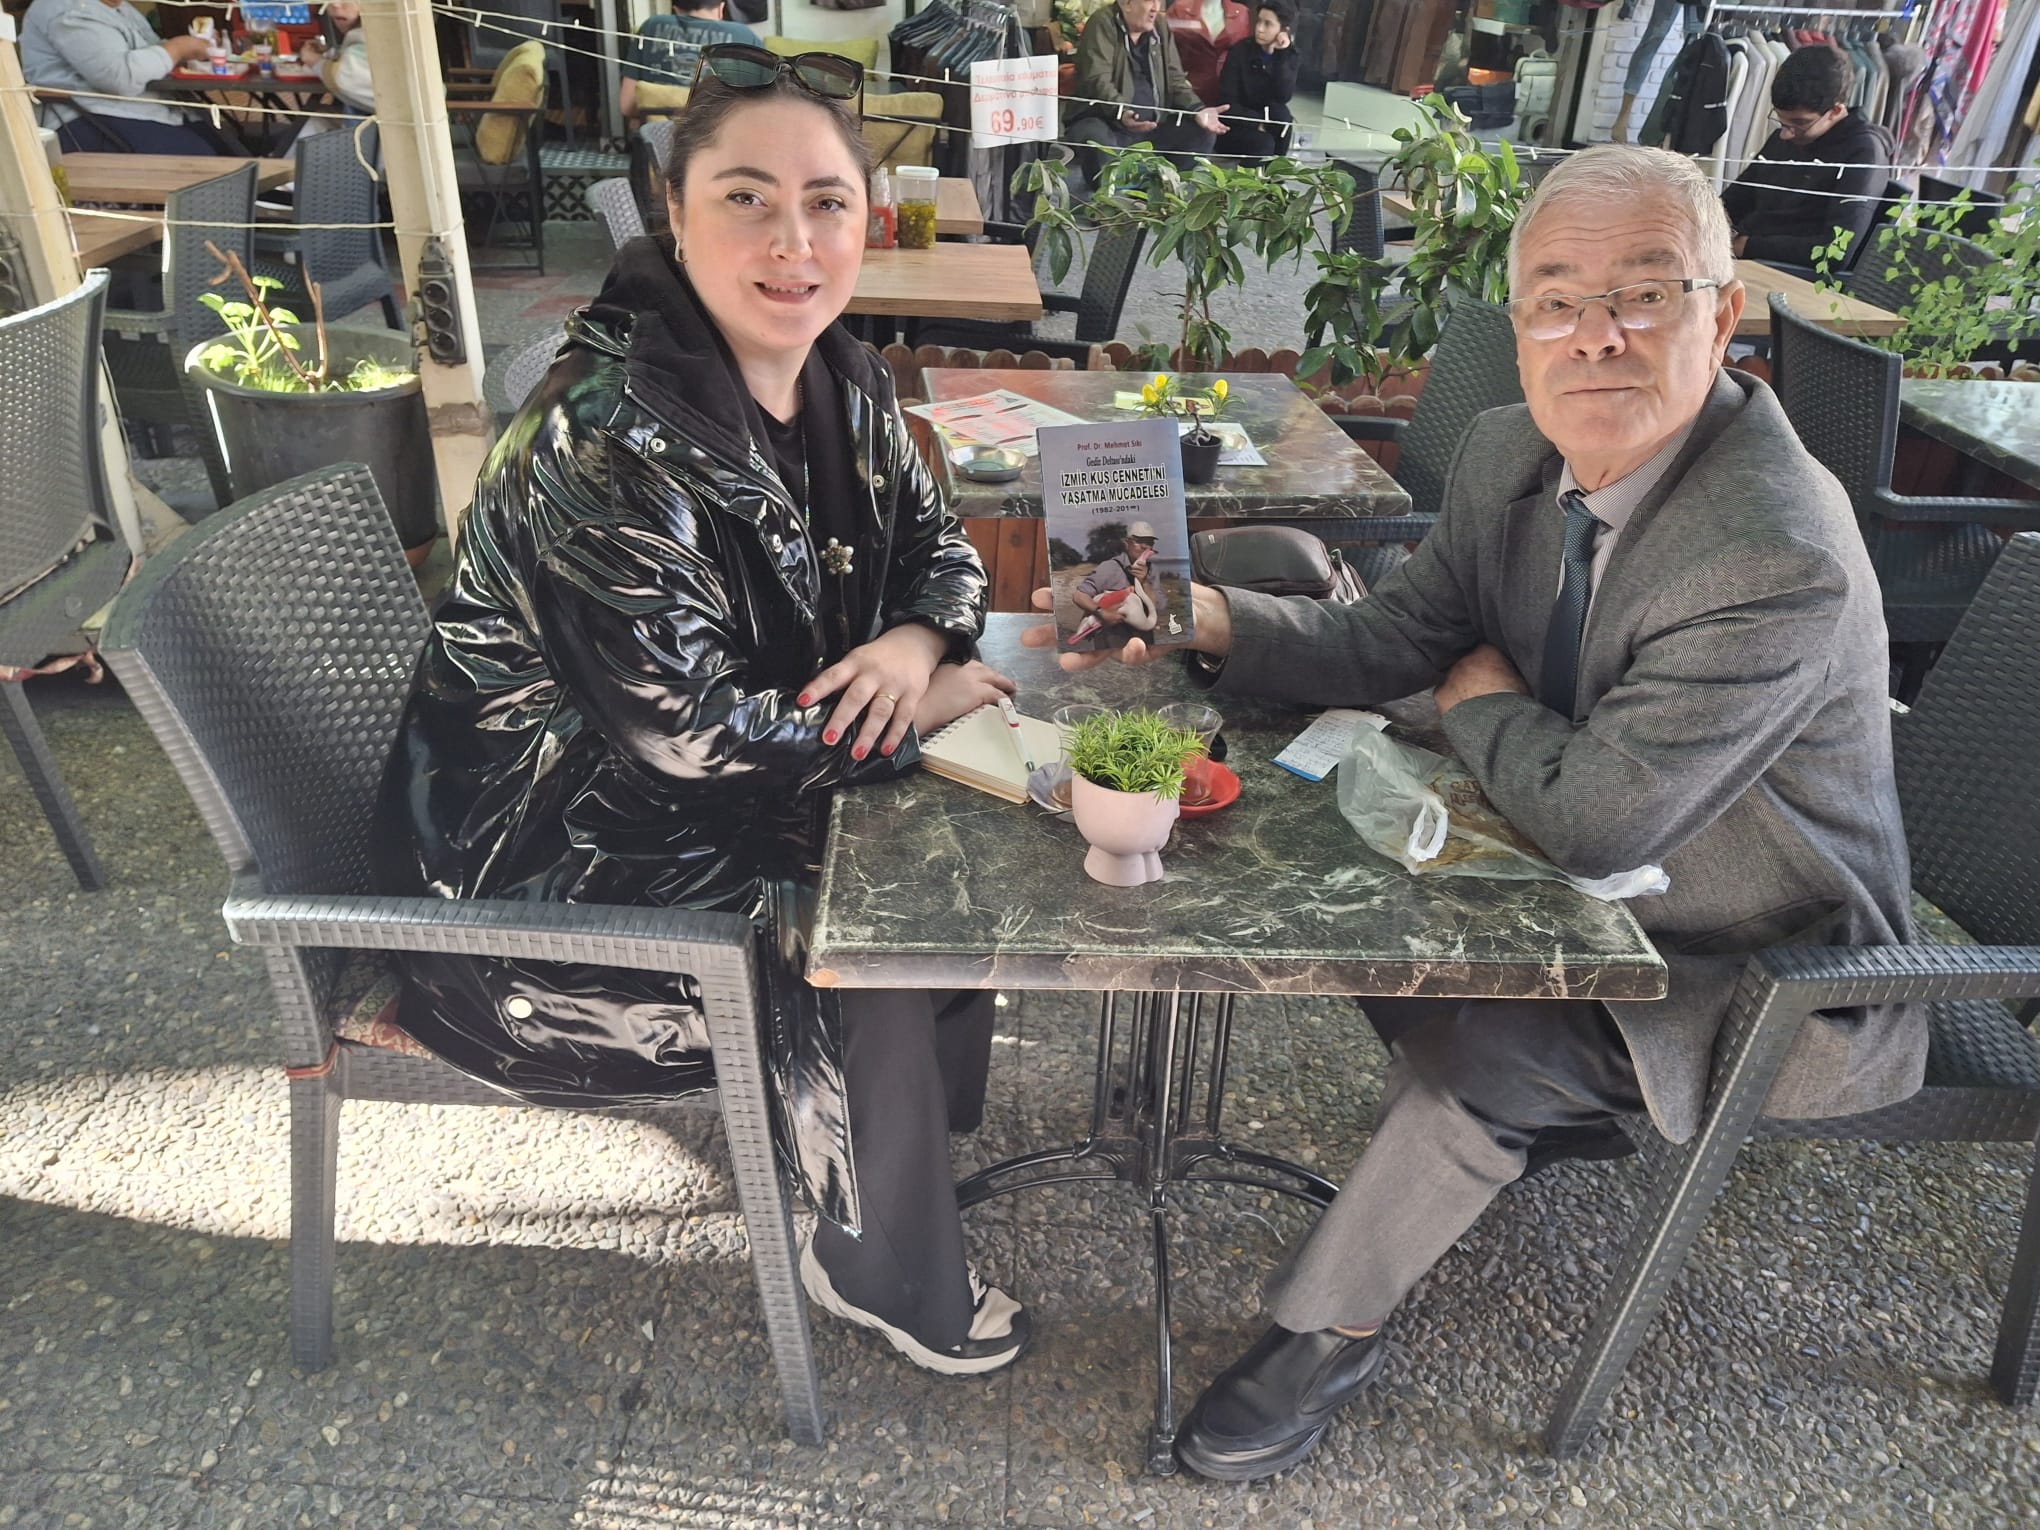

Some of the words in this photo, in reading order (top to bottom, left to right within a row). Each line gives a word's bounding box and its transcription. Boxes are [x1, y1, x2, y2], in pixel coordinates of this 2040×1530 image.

[1104, 440, 1130, 449] Mehmet
[1061, 469, 1088, 487] İZMİR
[1090, 471, 1110, 488] KUŞ
[1061, 489, 1107, 506] YAŞATMA
